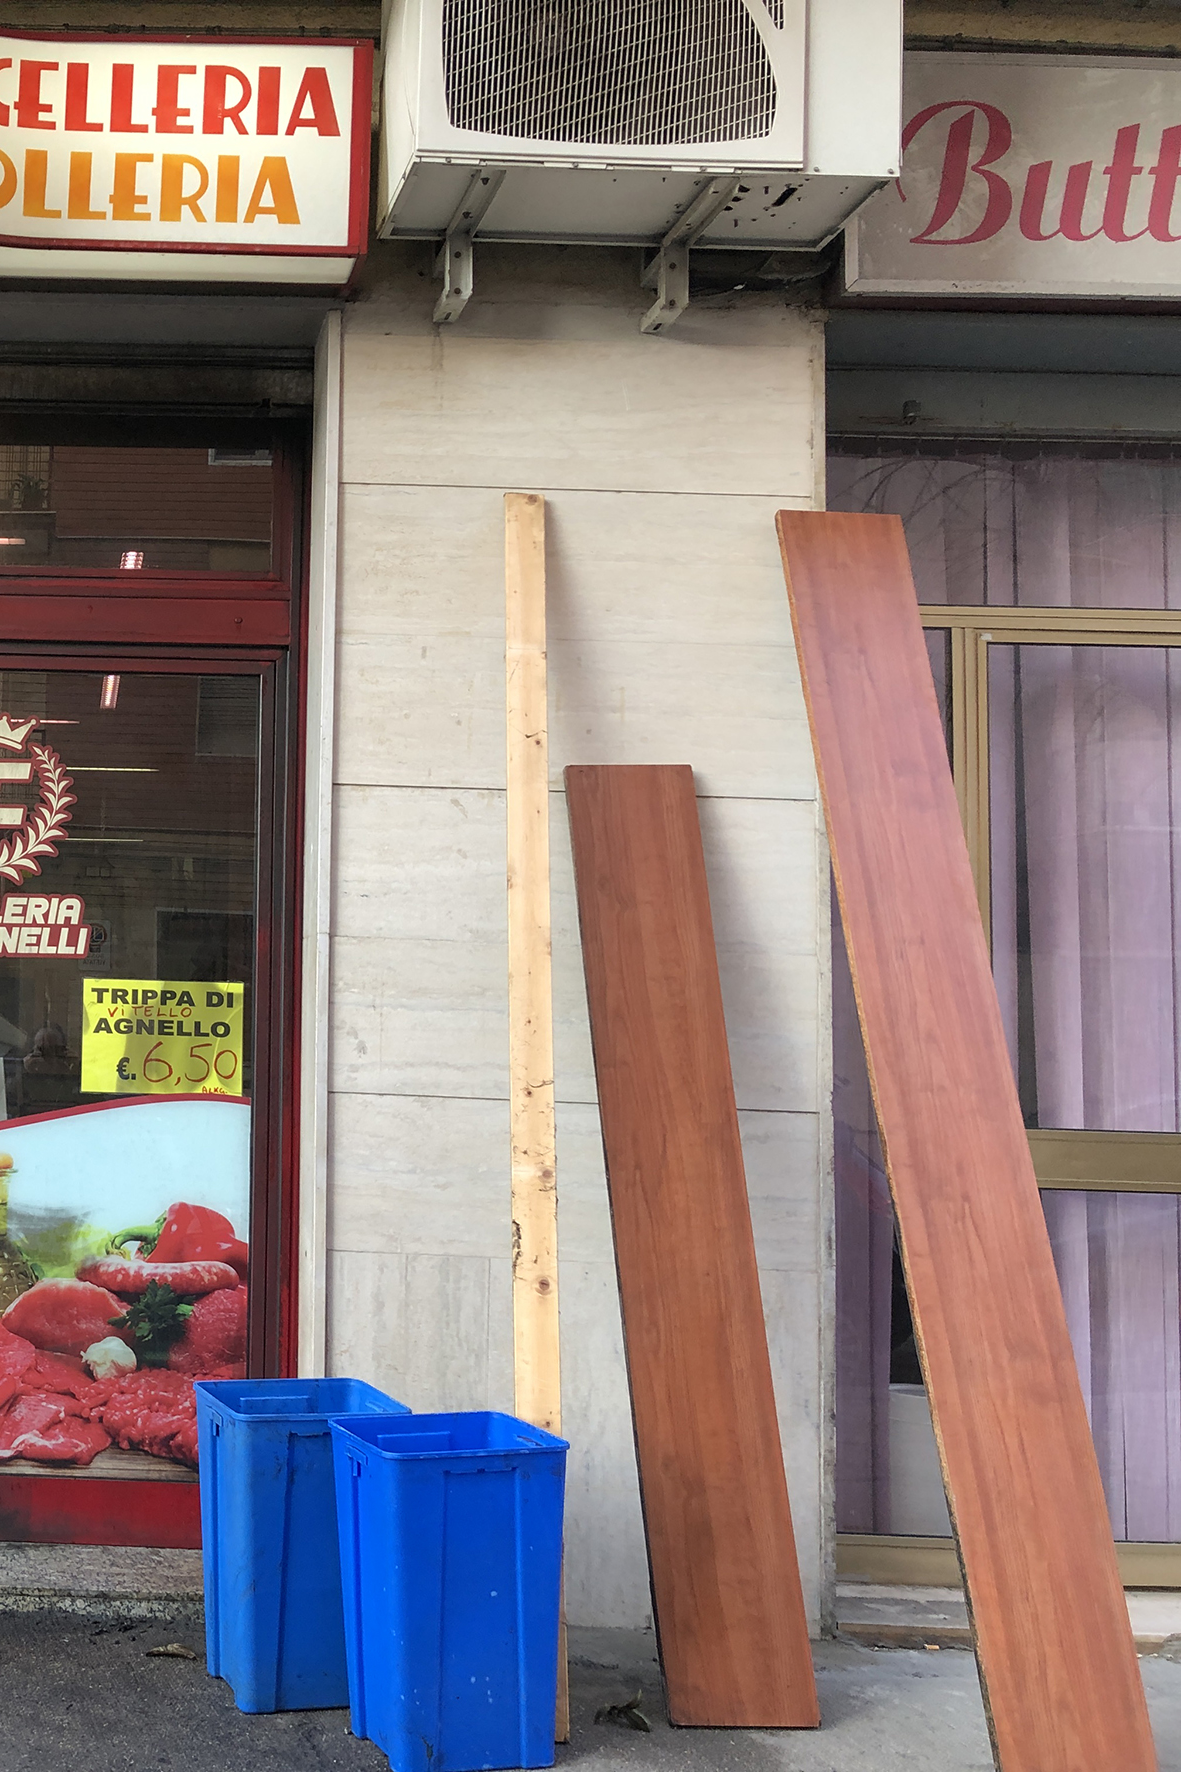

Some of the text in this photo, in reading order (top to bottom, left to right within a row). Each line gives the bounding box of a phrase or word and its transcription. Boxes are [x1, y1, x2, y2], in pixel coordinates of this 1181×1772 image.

[91, 987, 234, 1008] TRIPPA DI
[93, 1017, 231, 1038] AGNELLO
[143, 1041, 238, 1086] 6,50
